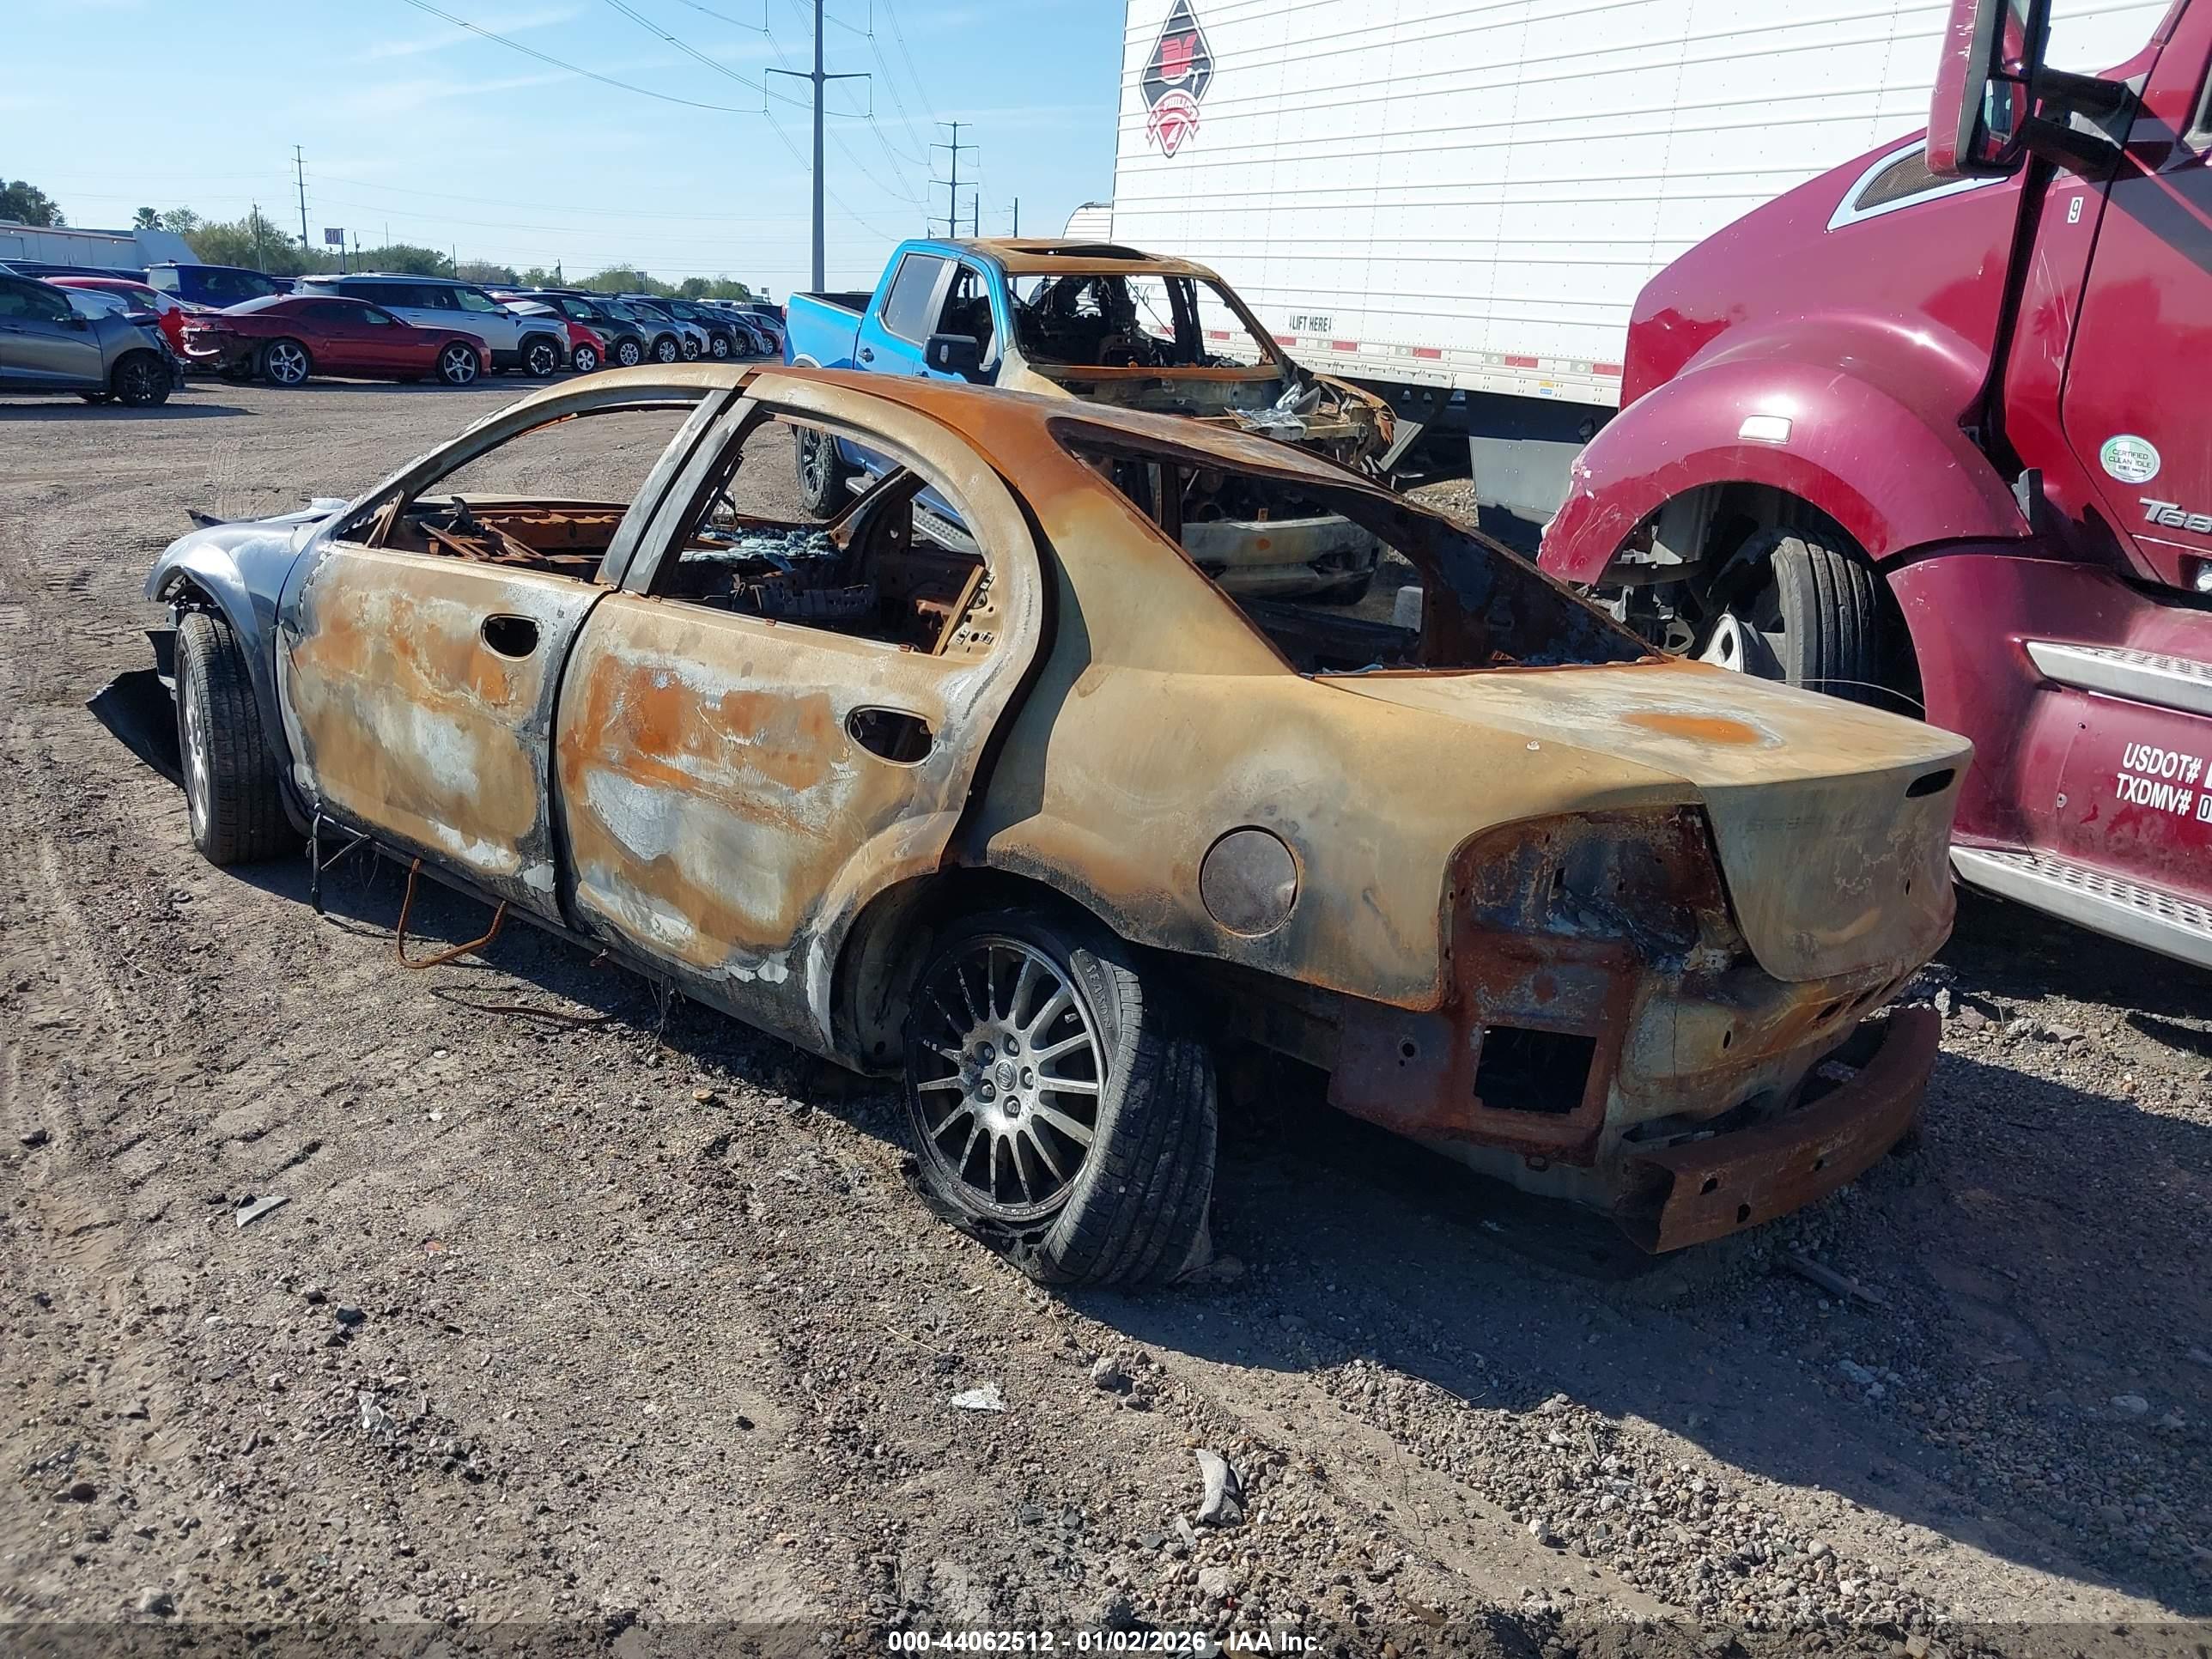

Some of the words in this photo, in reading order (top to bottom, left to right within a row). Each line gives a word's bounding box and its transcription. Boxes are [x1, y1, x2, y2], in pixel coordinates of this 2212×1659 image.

[2069, 198, 2081, 221] 9
[1291, 315, 1308, 331] LIFT
[1309, 316, 1328, 332] HERE
[2108, 455, 2133, 465] CLEAN
[2112, 448, 2148, 460] CERTIFIED
[2122, 742, 2203, 785] USDOT#
[2116, 772, 2193, 817] TXDMV#
